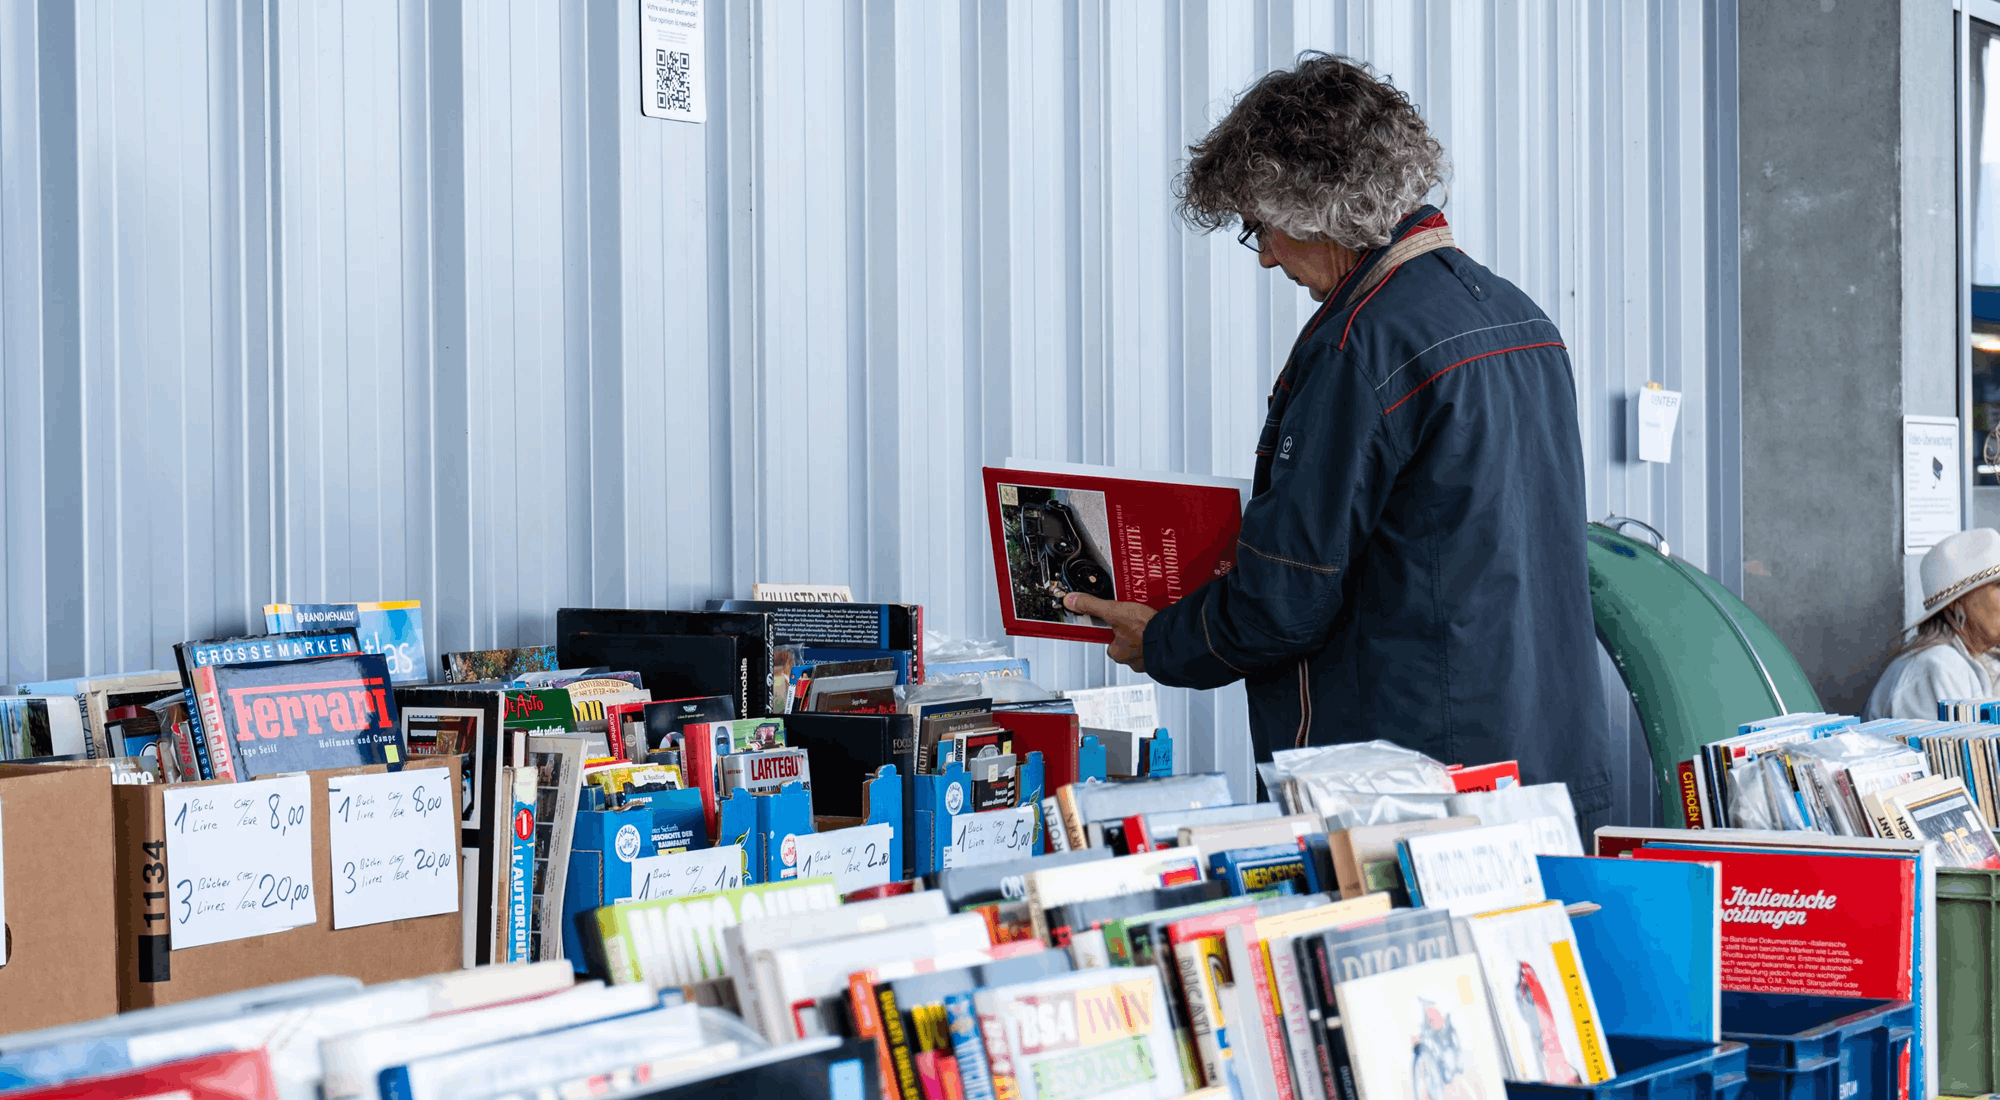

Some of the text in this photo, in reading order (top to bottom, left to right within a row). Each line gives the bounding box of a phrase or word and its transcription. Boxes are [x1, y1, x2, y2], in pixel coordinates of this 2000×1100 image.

[1126, 525, 1149, 603] GESCHICHTE
[1146, 553, 1162, 578] DES
[303, 612, 324, 623] RAND
[196, 638, 352, 665] GROSSE MARKEN
[364, 631, 414, 675] tlas
[740, 657, 748, 720] utomobils
[184, 688, 204, 746] MARKEN
[227, 677, 393, 742] Ferrari
[200, 691, 231, 776] Ferrari
[319, 734, 396, 749] Hoffmann und Campe
[608, 713, 617, 742] Günther
[239, 744, 278, 757] Ingo Seiff
[174, 802, 187, 834] 1
[190, 798, 214, 813] Buch
[268, 793, 304, 836] 8,00
[338, 796, 350, 823] 1
[355, 795, 376, 806] Buch
[412, 785, 442, 818] 8,00
[193, 820, 218, 833] Livre
[957, 825, 966, 852] 1
[968, 821, 983, 834] Buch
[1007, 819, 1030, 851] 5,00
[1044, 805, 1064, 853] ROEN
[343, 862, 356, 894] 3
[414, 848, 451, 876] 20,00
[803, 855, 811, 878] 1
[815, 851, 831, 862] Buch
[142, 839, 165, 928] 1134
[638, 872, 650, 901] 1
[653, 868, 671, 879] Buch
[1724, 885, 1837, 910] Italienische
[177, 879, 193, 924] 3
[197, 877, 231, 891] Bücher
[259, 873, 309, 910] 20,00
[197, 901, 225, 915] Livres
[511, 852, 530, 963] L'AUTOROUT
[1759, 937, 1807, 946] Dokumentation
[1759, 945, 1790, 953] berühmte
[1790, 947, 1814, 955] Marken
[1736, 961, 1760, 969] weniger
[1797, 955, 1825, 963] Erstmals
[1726, 974, 1751, 983] Beispiel
[1843, 981, 1859, 989] oder
[1733, 967, 1768, 977] Bedeutung
[1768, 970, 1790, 978] jedoch
[1816, 972, 1847, 981] wichtigen
[1753, 984, 1769, 992] Auch
[1770, 985, 1800, 993] berühmte
[1179, 956, 1211, 1037] DUCATI
